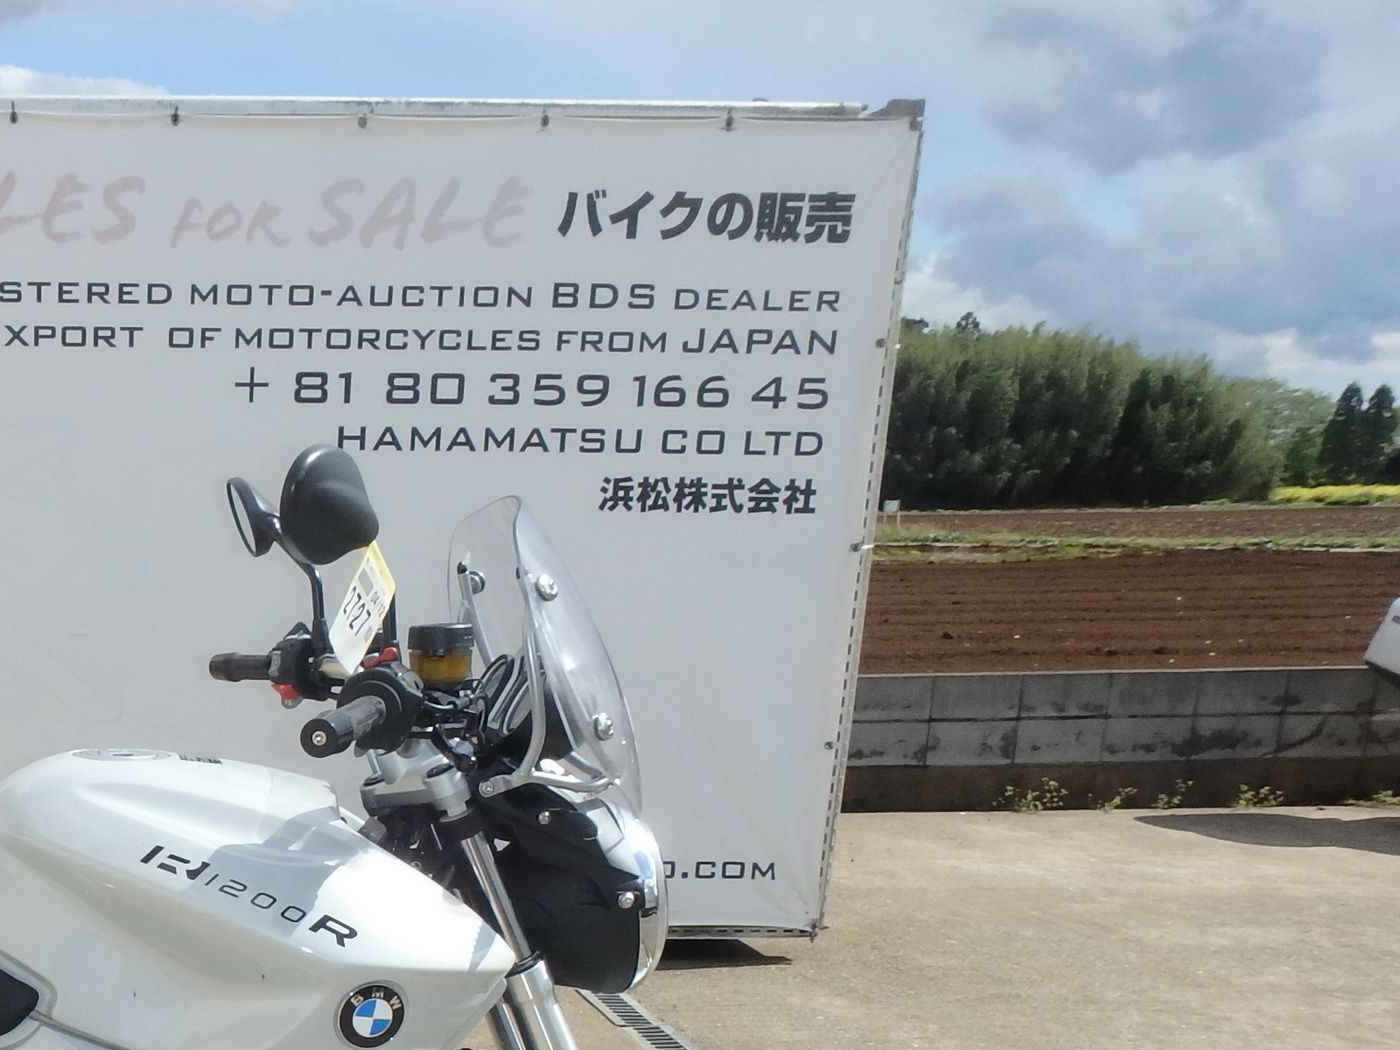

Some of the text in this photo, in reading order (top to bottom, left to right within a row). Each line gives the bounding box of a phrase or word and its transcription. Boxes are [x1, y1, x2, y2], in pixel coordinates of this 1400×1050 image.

[307, 175, 537, 251] SALE
[557, 190, 857, 245] バイクの販売
[190, 283, 533, 308] MOTO-AUCTION
[551, 282, 656, 310] BDS
[673, 288, 841, 313] DEALER
[168, 326, 222, 349] OF
[234, 327, 541, 352] MOTORCYCLES
[556, 330, 668, 354] FROM
[681, 328, 838, 356] JAPAN
[293, 371, 352, 404] 81
[385, 372, 466, 405] 80
[487, 373, 610, 407] 359
[632, 374, 730, 409] 166
[750, 376, 829, 410] 45
[337, 425, 824, 457] HAMAMATSU CO LTD
[598, 477, 817, 515] 浜松株式会社
[342, 585, 372, 637] 2727
[350, 986, 402, 1010] BMW
